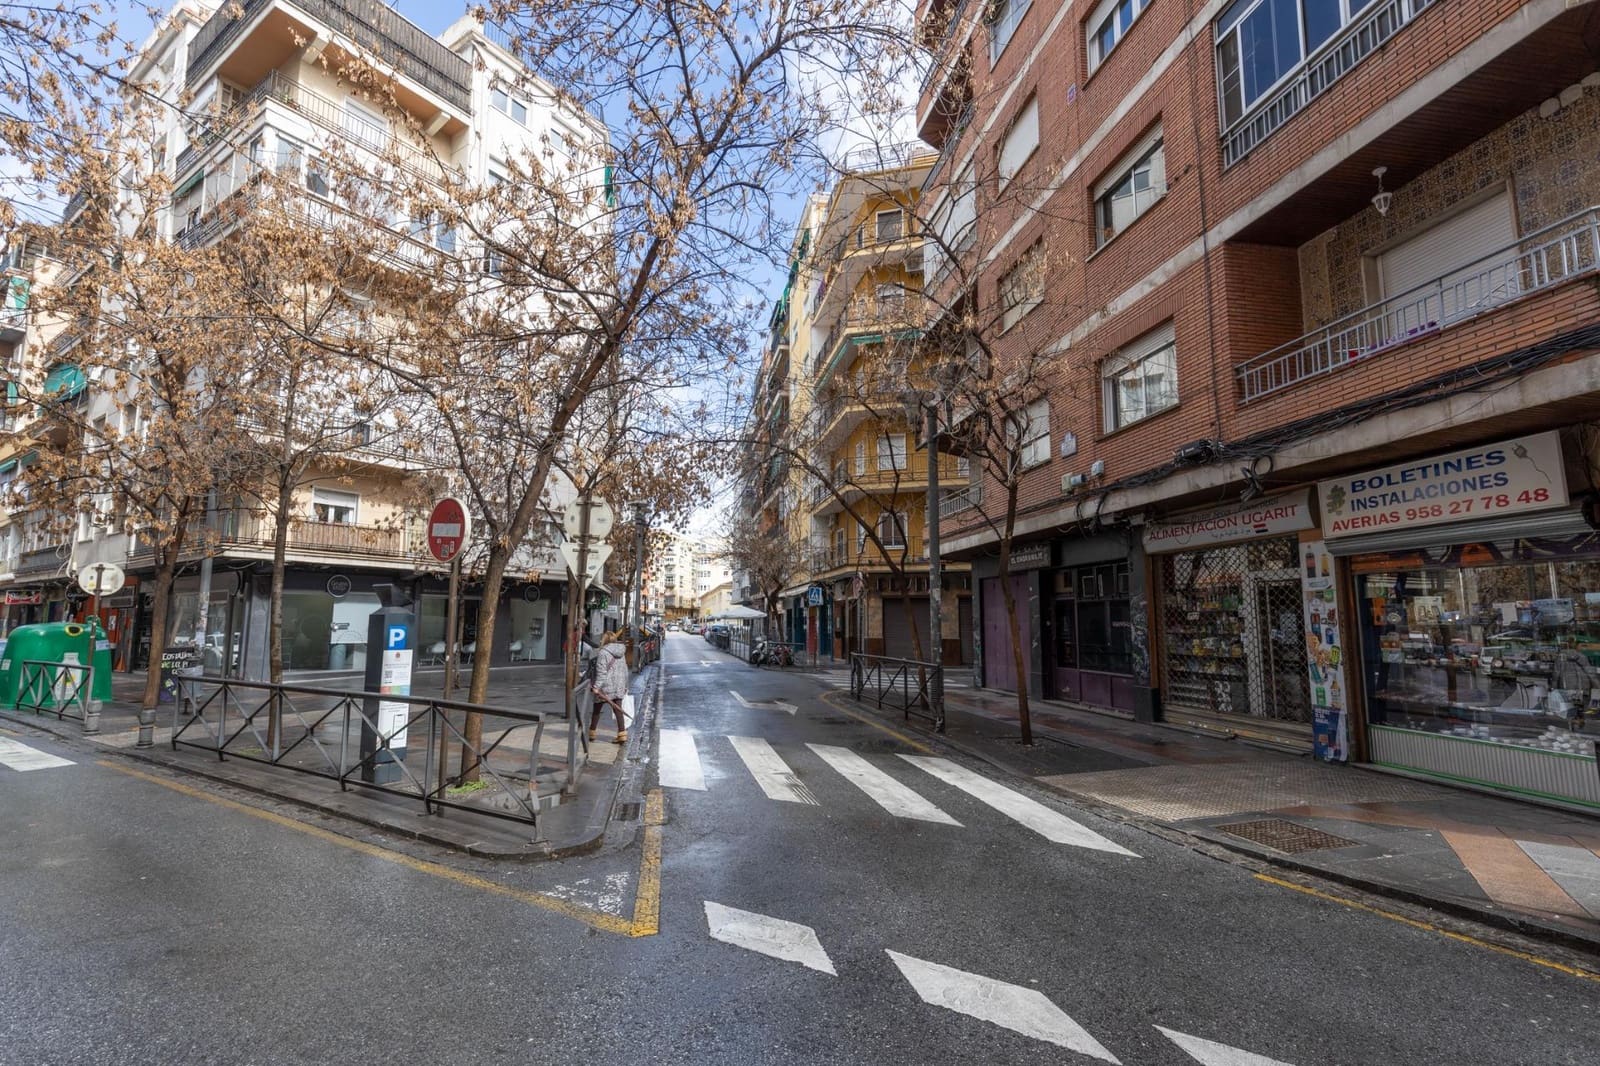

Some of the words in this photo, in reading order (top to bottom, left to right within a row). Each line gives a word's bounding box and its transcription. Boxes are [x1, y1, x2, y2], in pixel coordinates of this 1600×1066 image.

[1350, 471, 1509, 512] INSTALACIONES
[1351, 450, 1506, 493] BOLETINES
[1148, 516, 1238, 541] ALIMENTACION
[1241, 504, 1298, 526] UGARIT
[1332, 511, 1401, 532] AVERIAS
[1405, 503, 1443, 521] 958
[1449, 499, 1474, 515] 27
[1480, 494, 1510, 510] 78
[1516, 487, 1550, 504] 48
[388, 628, 406, 648] P
